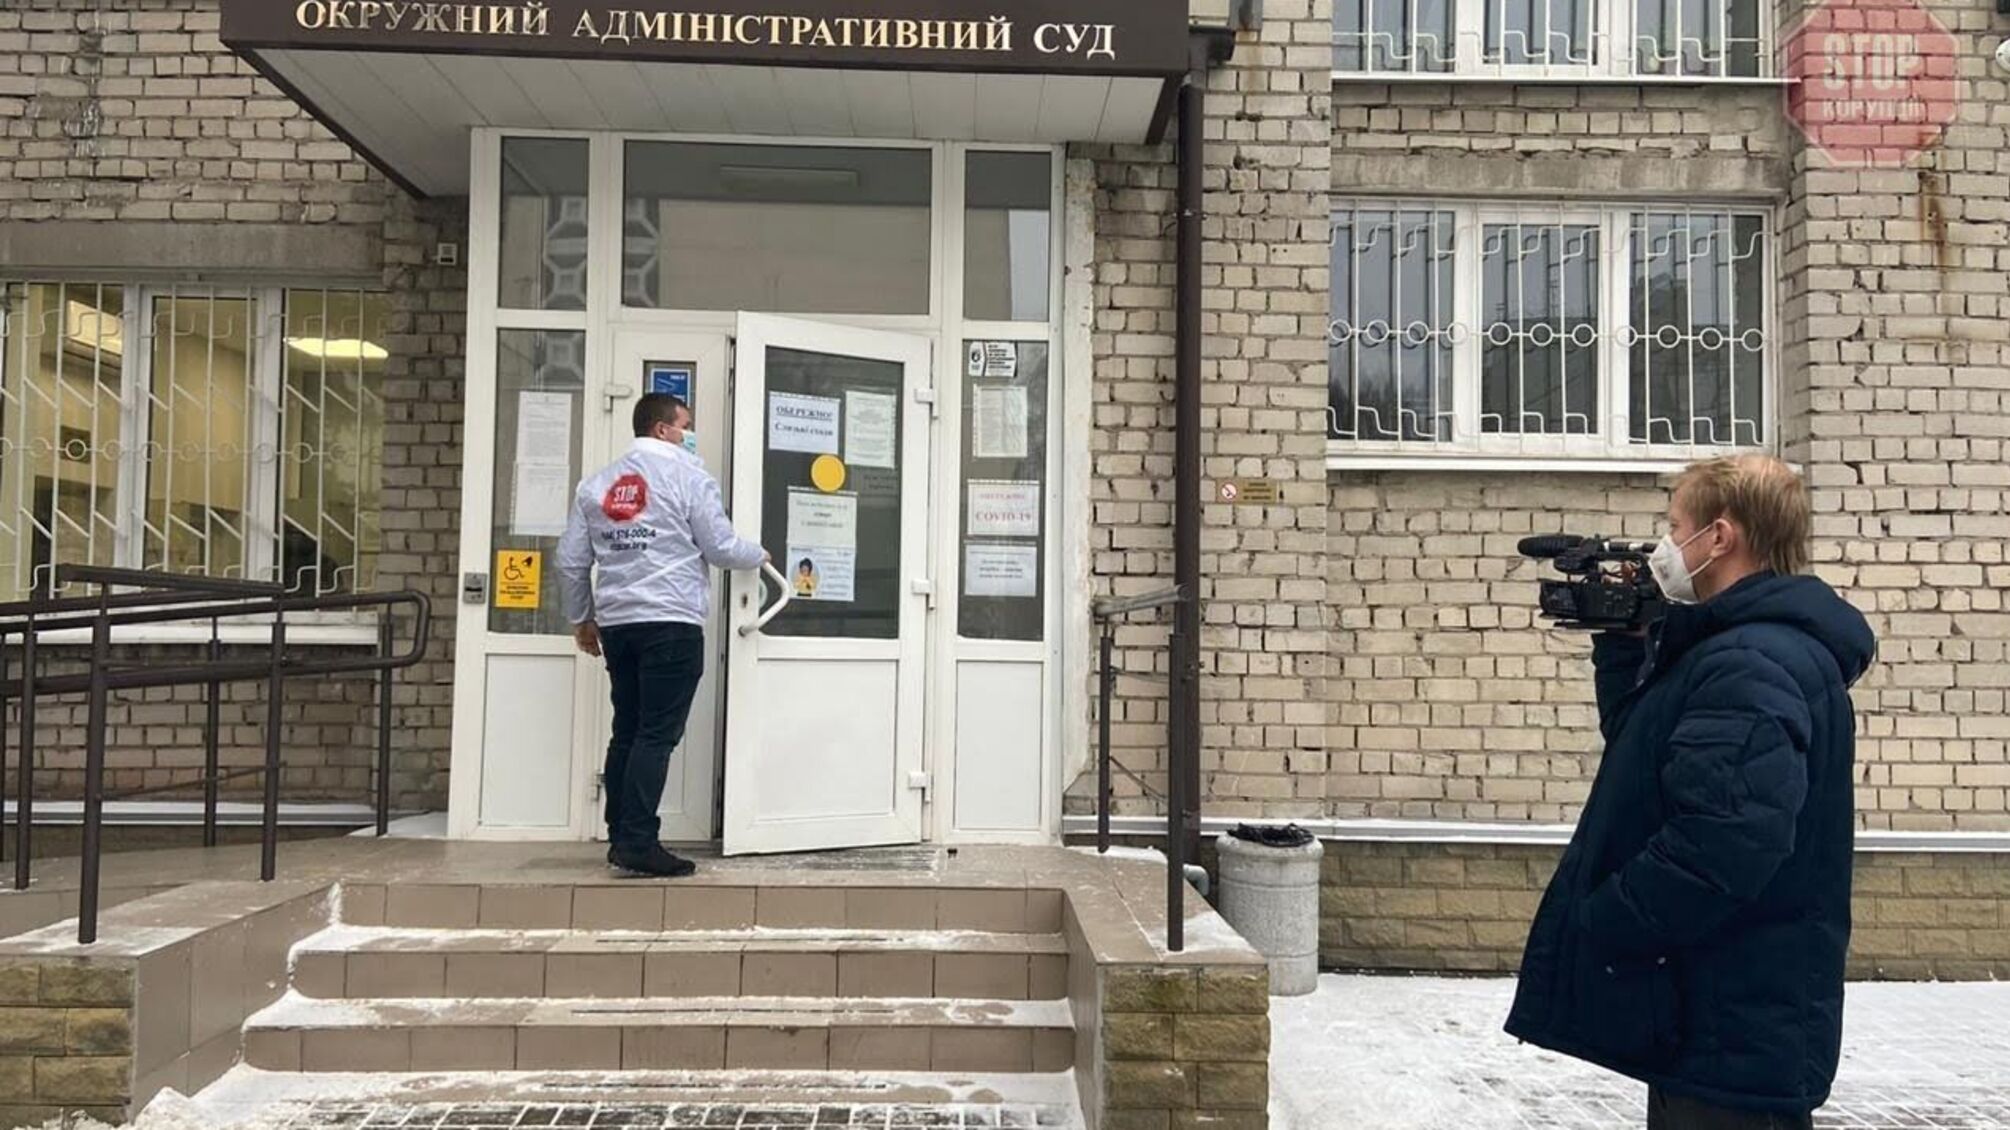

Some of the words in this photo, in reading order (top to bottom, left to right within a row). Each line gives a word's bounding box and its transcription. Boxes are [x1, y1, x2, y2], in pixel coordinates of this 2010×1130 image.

[295, 0, 551, 36] ОКРУЖНИЙ
[571, 8, 1013, 52] АДМІНІСТРАТИВНИЙ
[1033, 22, 1116, 60] СУД
[613, 485, 639, 502] STOP
